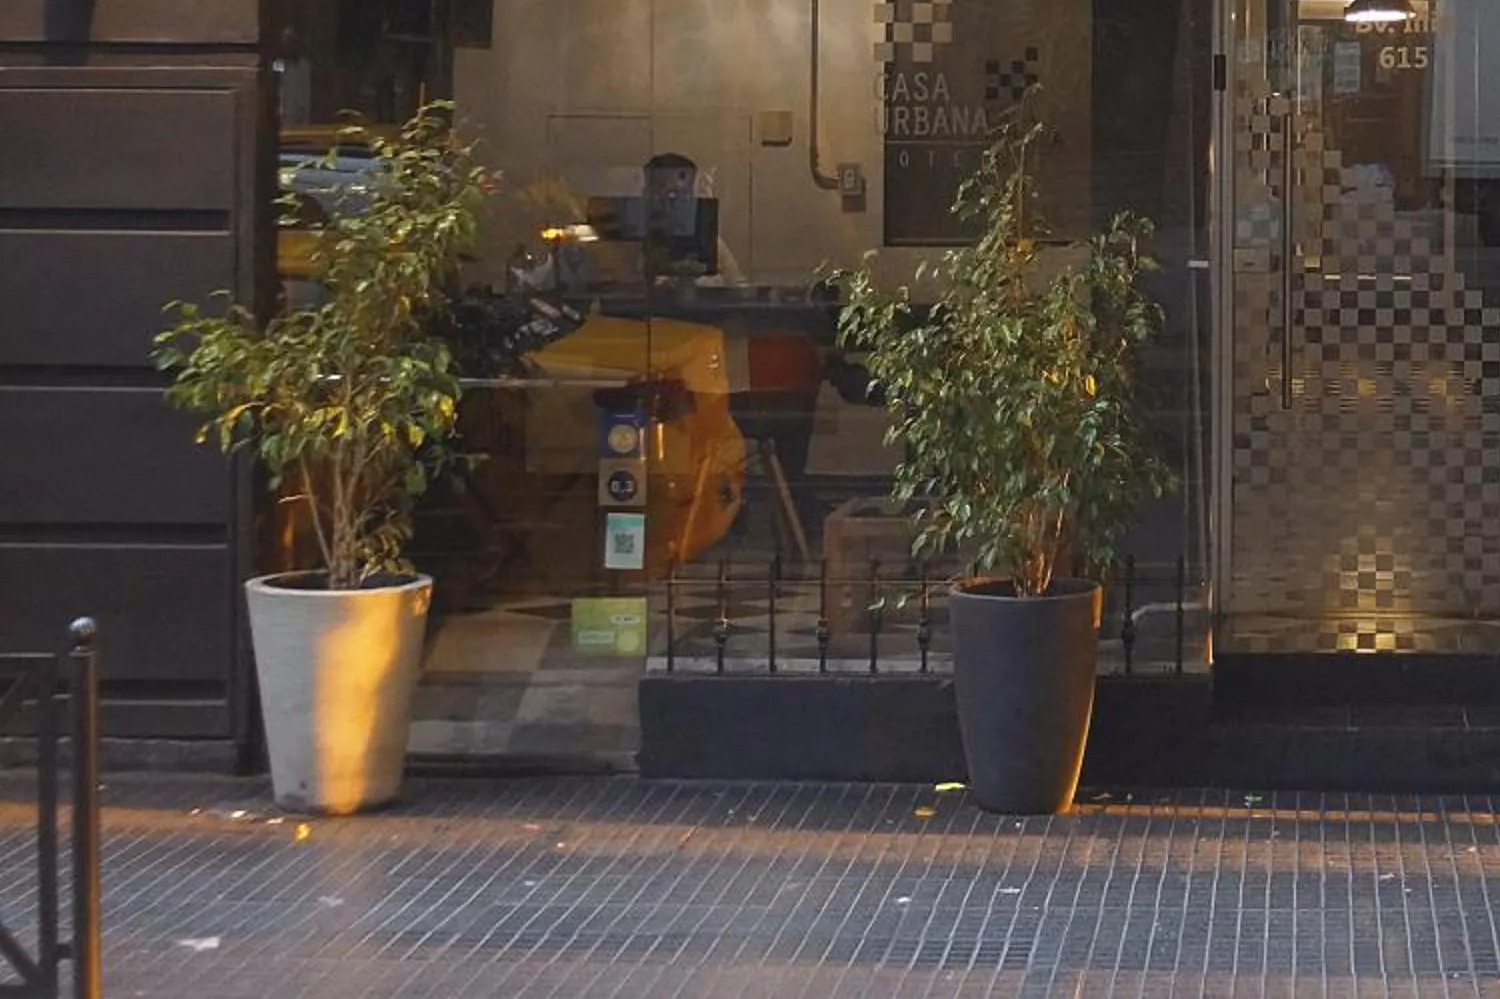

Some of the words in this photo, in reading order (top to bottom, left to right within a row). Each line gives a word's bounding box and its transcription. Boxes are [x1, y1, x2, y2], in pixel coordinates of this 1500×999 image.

[1380, 46, 1429, 70] 615
[872, 71, 951, 102] CASA
[873, 104, 988, 136] URBANA
